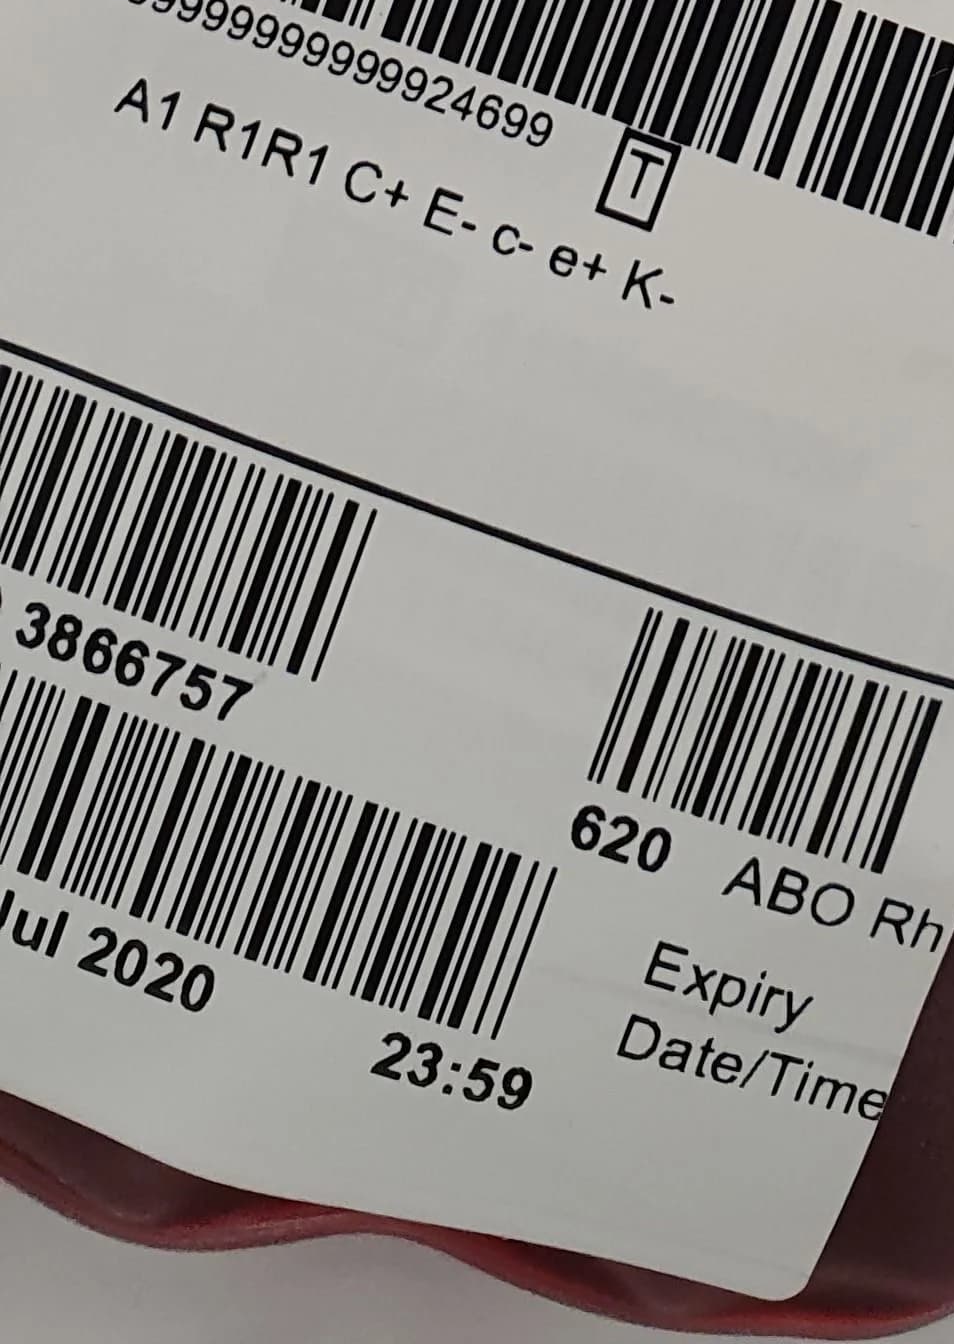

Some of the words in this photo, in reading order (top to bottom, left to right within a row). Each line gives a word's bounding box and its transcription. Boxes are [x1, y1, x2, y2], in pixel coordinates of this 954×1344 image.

[115, 78, 182, 131] A1
[193, 102, 329, 187] R1R1
[344, 160, 409, 207] C+
[423, 186, 477, 236] E-
[492, 223, 534, 256] c-
[549, 244, 608, 282] e+
[621, 260, 675, 310] K-
[15, 601, 254, 721] 3866757
[570, 805, 672, 873] 620
[0, 889, 69, 958] Jul
[77, 926, 217, 1012] 2020
[722, 856, 855, 927] ABO
[869, 897, 944, 953] Rh
[643, 940, 814, 1034] Expiry
[370, 1031, 534, 1111] 23:59
[616, 1013, 889, 1121] Date/Time
